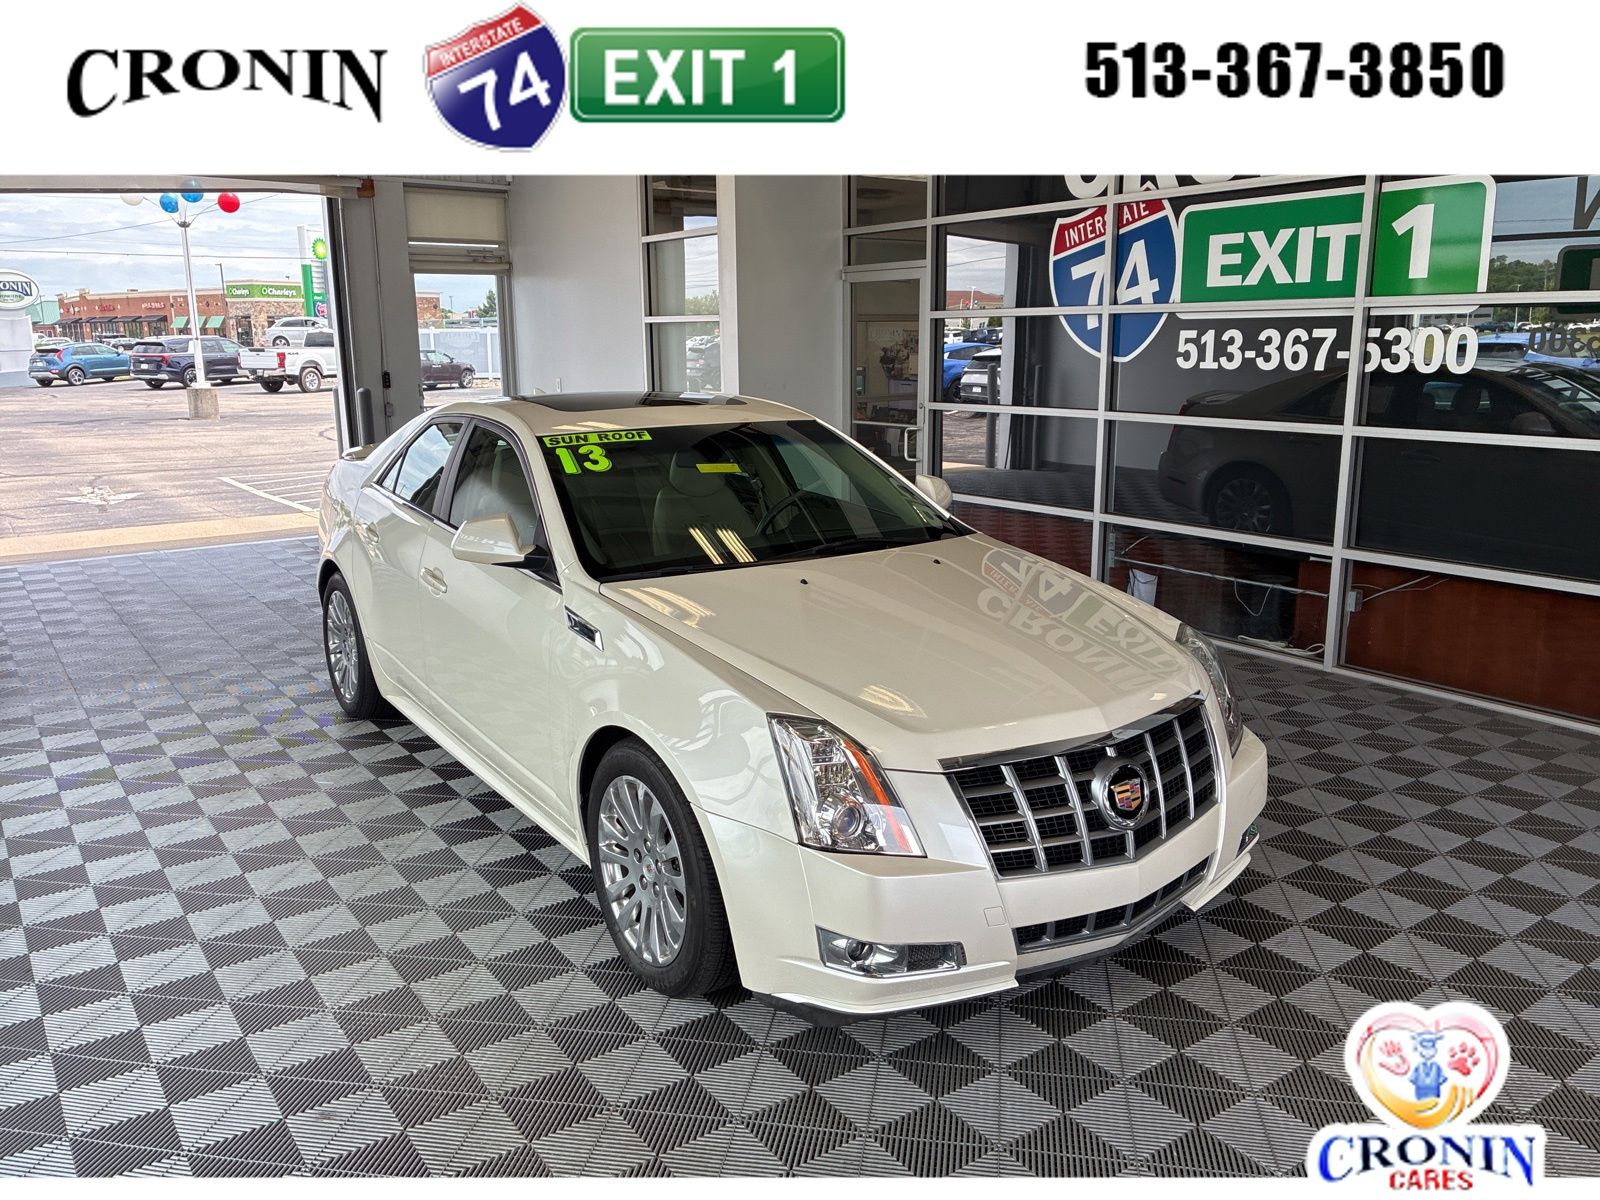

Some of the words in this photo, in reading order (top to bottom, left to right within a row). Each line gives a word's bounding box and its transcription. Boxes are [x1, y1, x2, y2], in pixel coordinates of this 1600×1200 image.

[1206, 222, 1362, 288] EXIT
[1391, 203, 1435, 279] 1
[1070, 239, 1160, 331] 74
[1176, 327, 1479, 374] 513-367-5300
[548, 434, 589, 446] SUN
[597, 431, 646, 442] ROOF
[556, 445, 613, 474] 13
